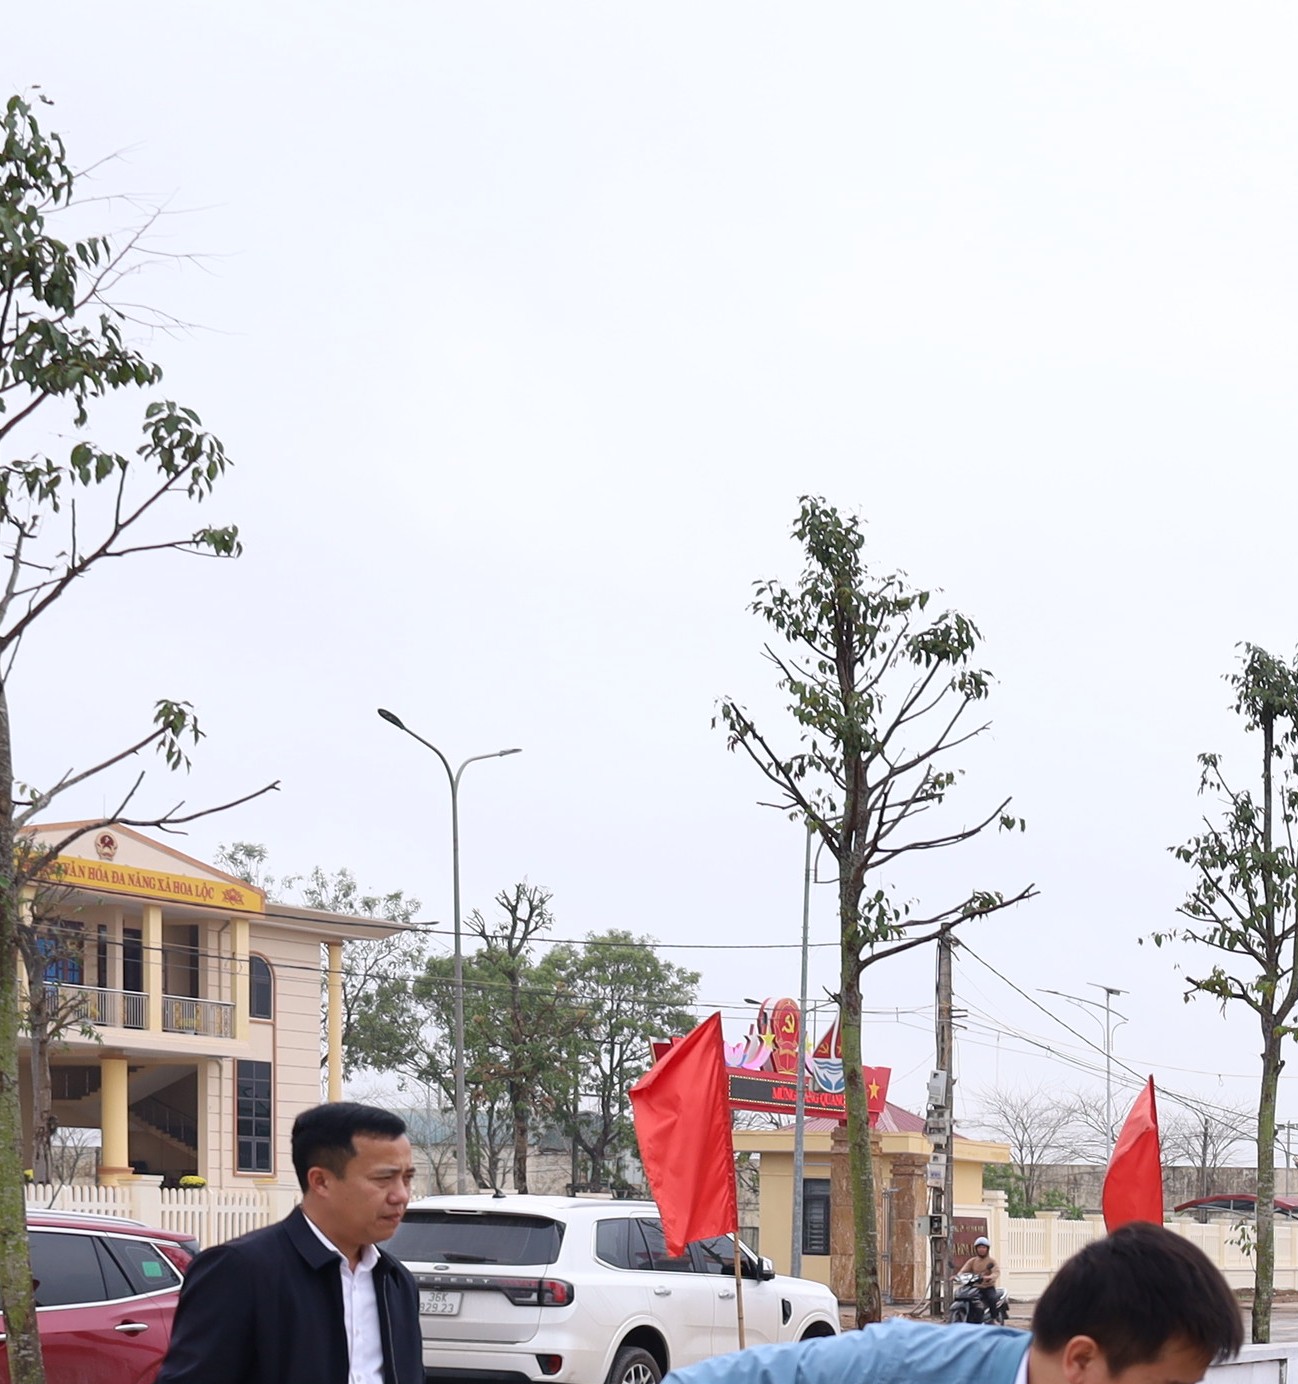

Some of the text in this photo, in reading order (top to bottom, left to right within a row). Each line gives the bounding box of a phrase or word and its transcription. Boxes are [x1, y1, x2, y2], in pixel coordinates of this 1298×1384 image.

[88, 865, 109, 883] HÓA
[111, 870, 125, 885] ĐA
[173, 884, 194, 896] HOA
[194, 881, 215, 901] LỘC
[419, 1276, 490, 1284] EREST
[428, 1292, 448, 1302] 36K
